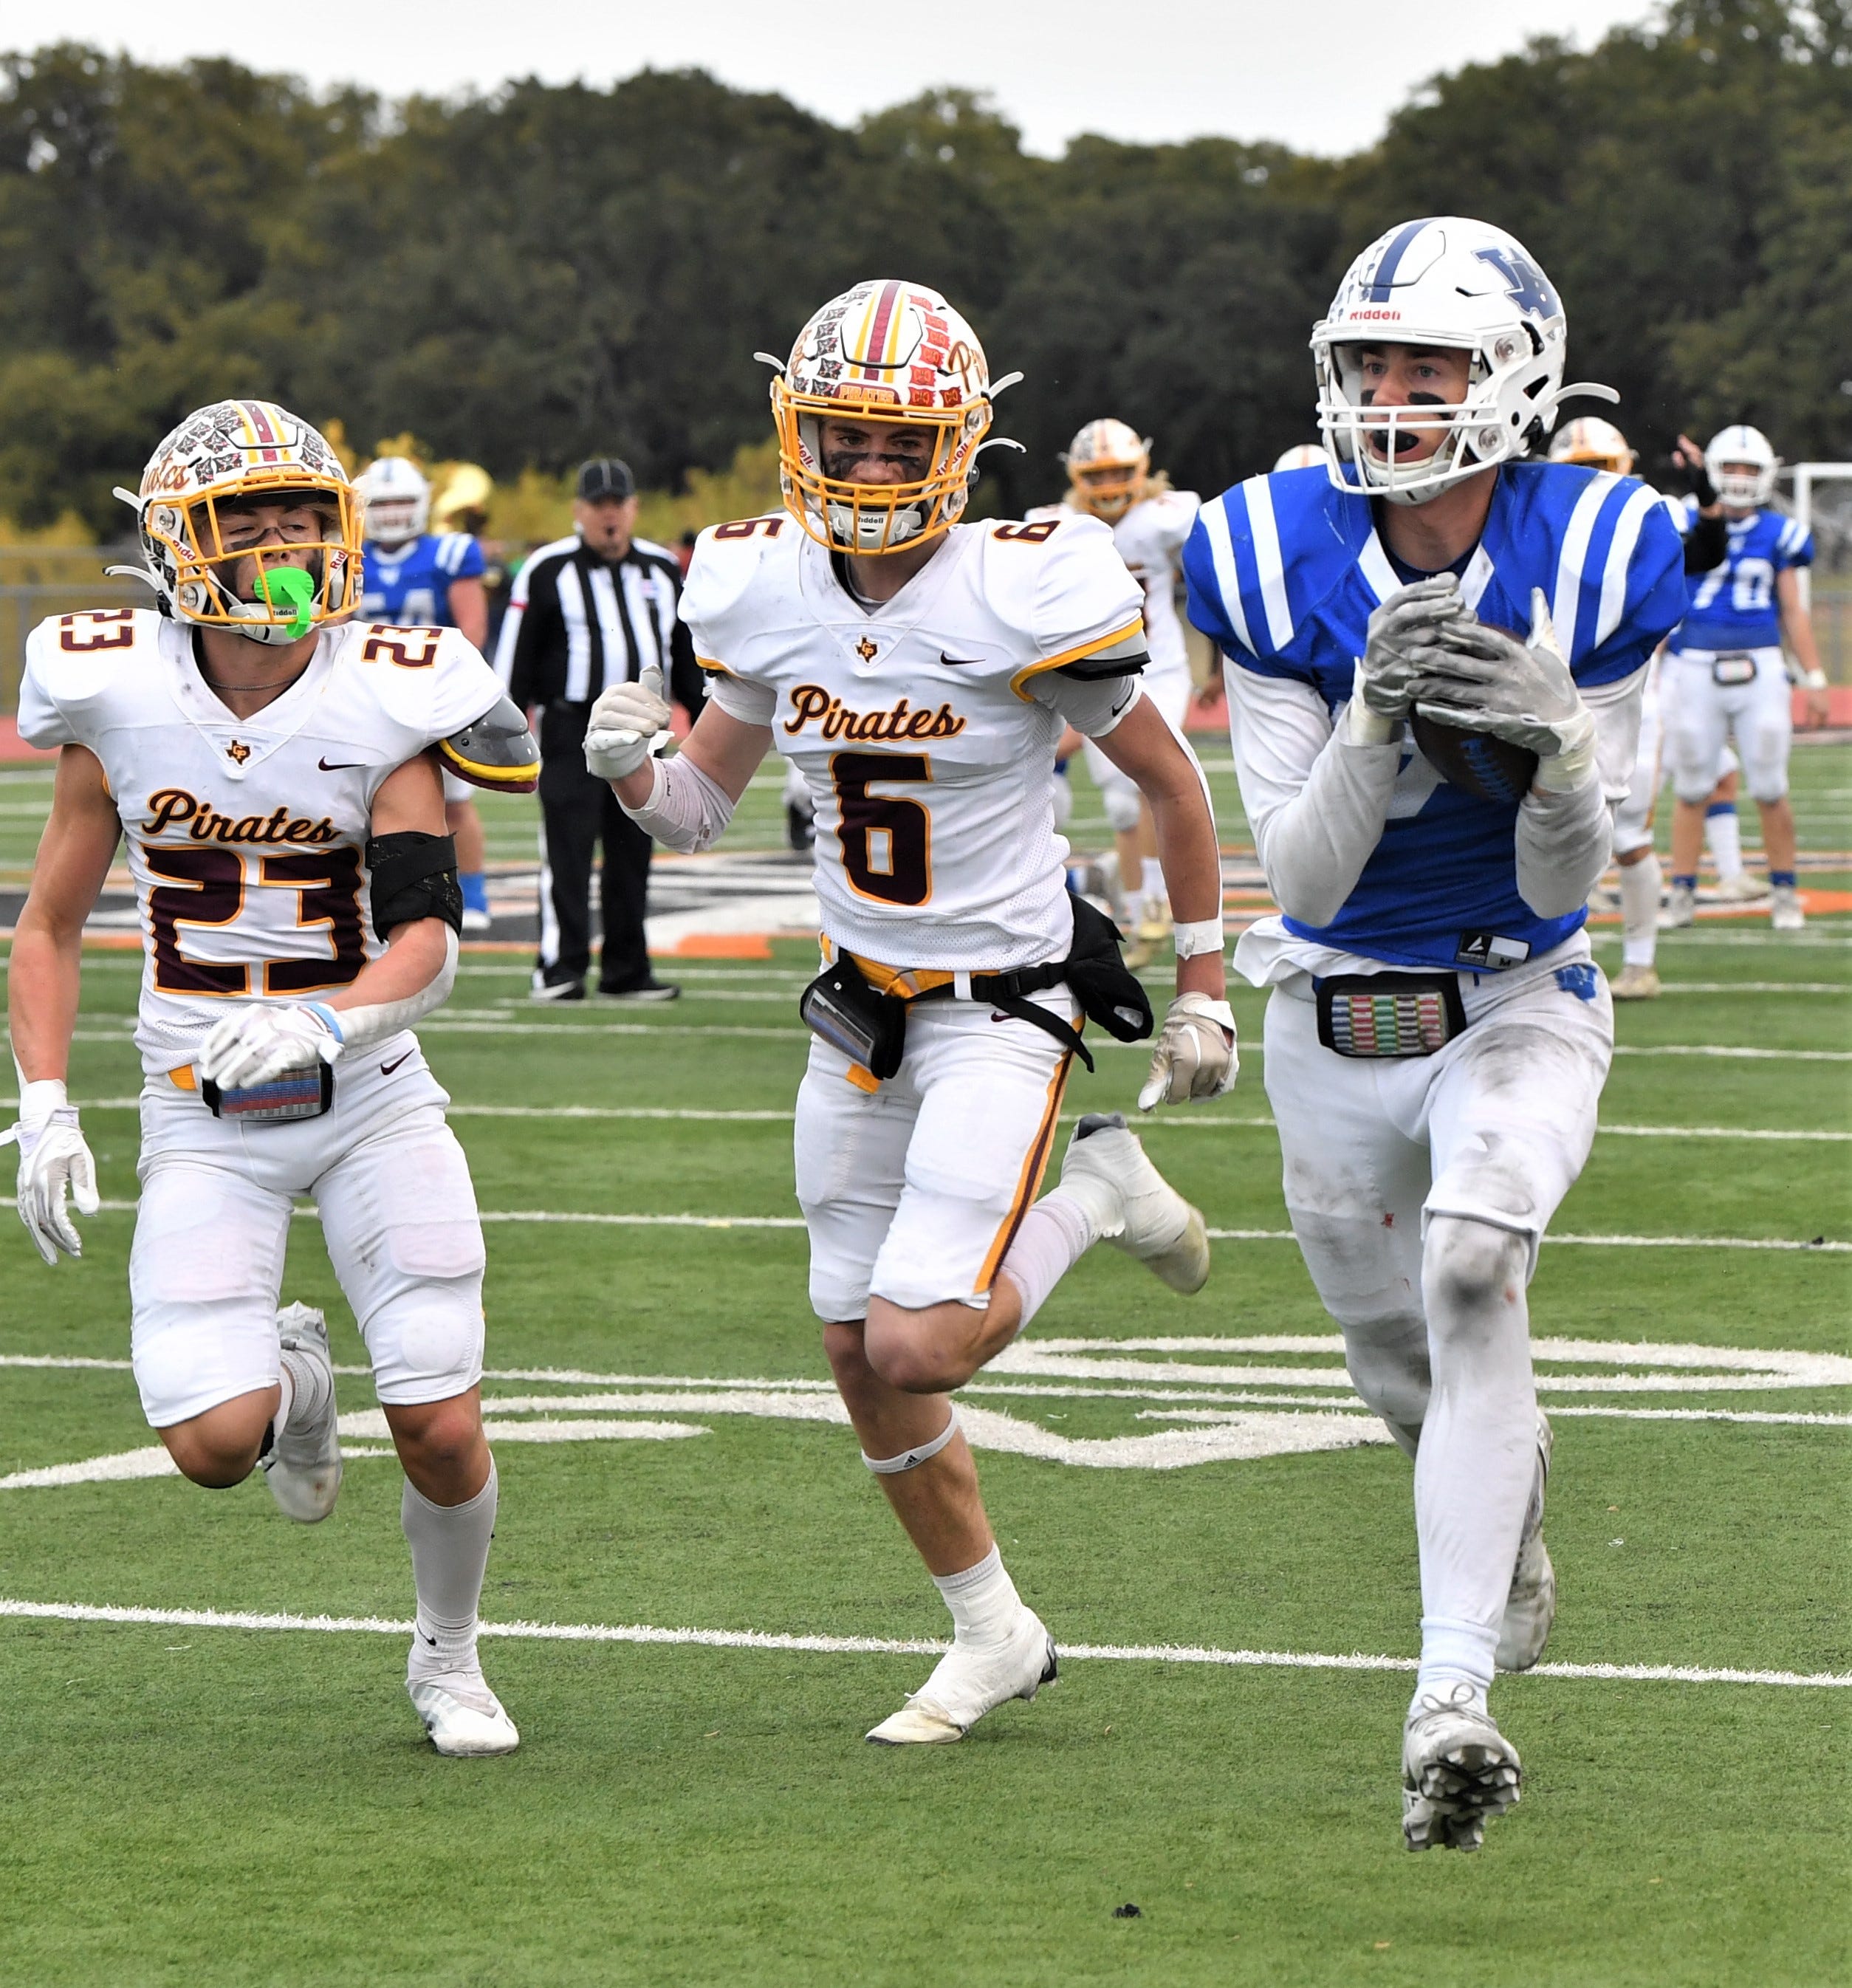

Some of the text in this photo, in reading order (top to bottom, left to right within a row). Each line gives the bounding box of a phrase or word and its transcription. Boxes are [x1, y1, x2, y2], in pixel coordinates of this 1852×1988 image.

[1350, 310, 1401, 321] Riddell
[839, 385, 895, 405] PIRATES
[712, 518, 786, 541] 6
[991, 520, 1062, 544] 6
[360, 624, 444, 670] 23
[783, 684, 967, 743] Pirates
[142, 788, 345, 845] Pirates
[828, 751, 933, 906] 6
[139, 837, 371, 997] 23
